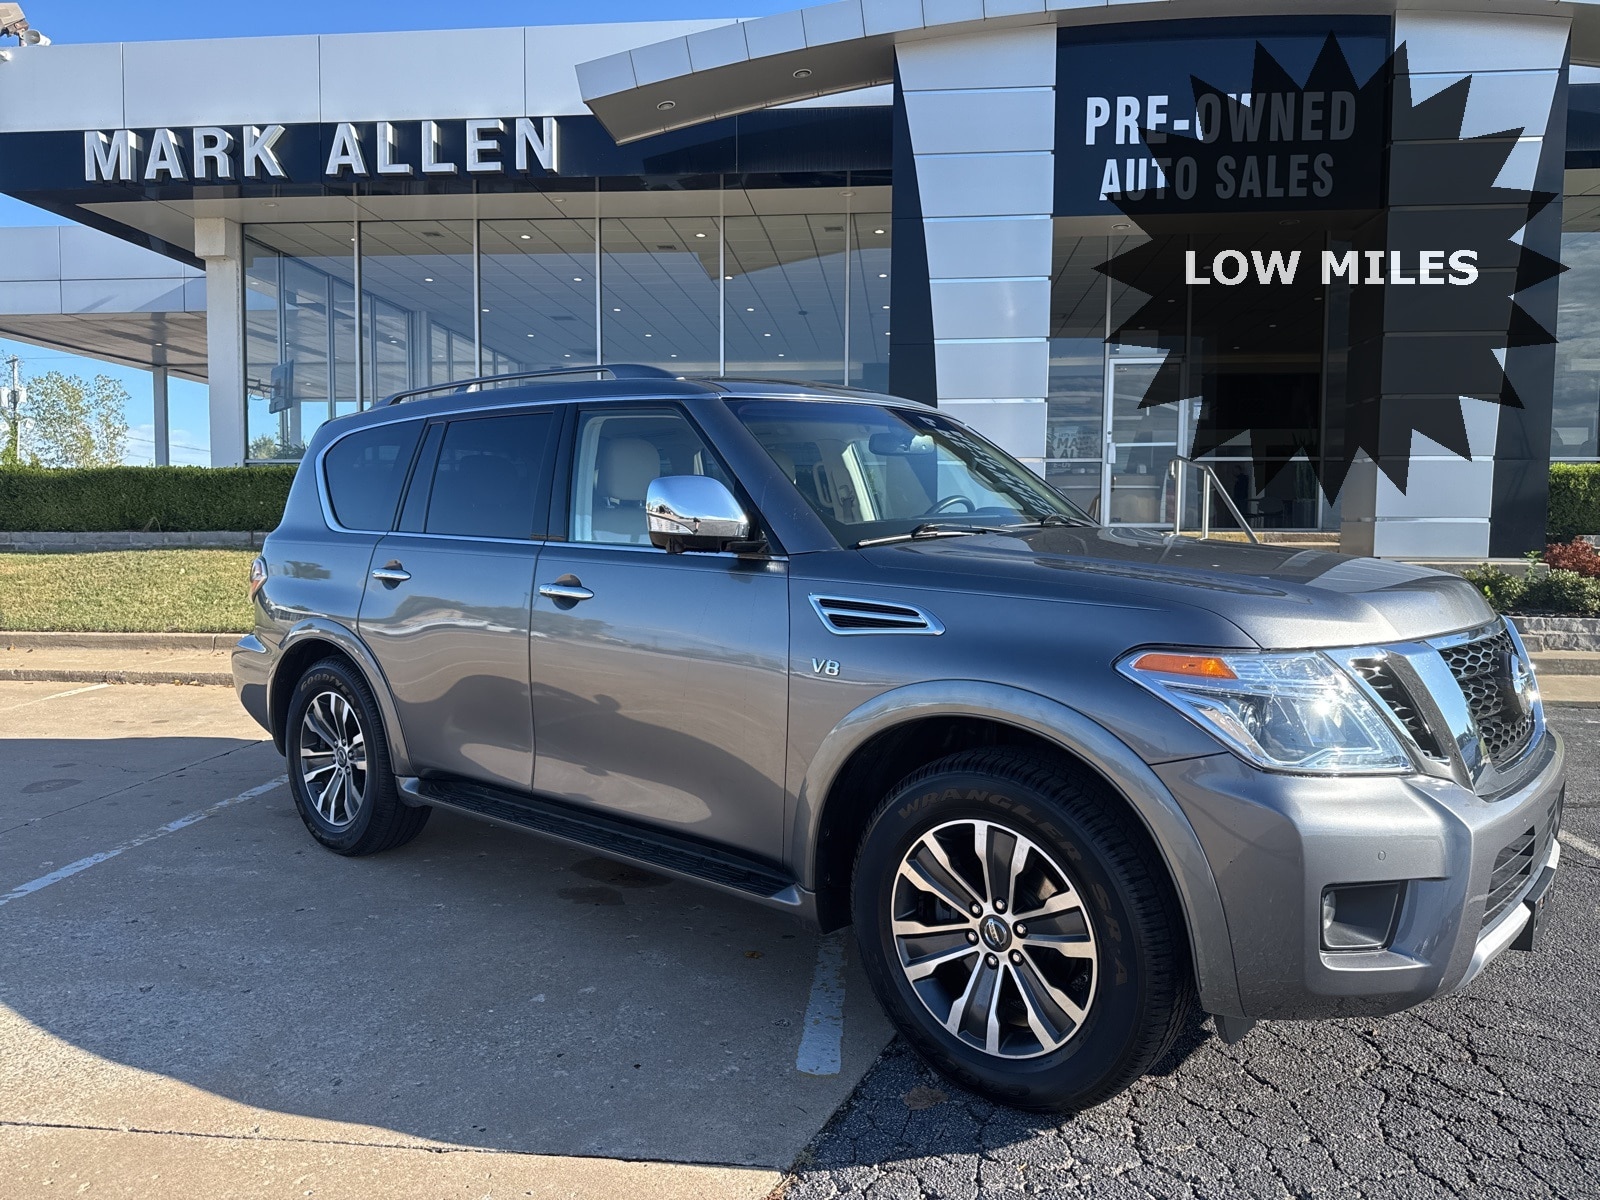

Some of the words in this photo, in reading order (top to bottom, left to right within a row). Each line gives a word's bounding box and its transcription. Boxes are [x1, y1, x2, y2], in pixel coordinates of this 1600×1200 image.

[1085, 91, 1356, 145] PRE-OWNED
[84, 125, 286, 182] MARK
[325, 116, 559, 177] ALLEN
[1099, 156, 1198, 200] AUTO
[1215, 153, 1334, 198] SALES
[811, 657, 841, 677] V8
[898, 788, 1082, 861] WRANGLER
